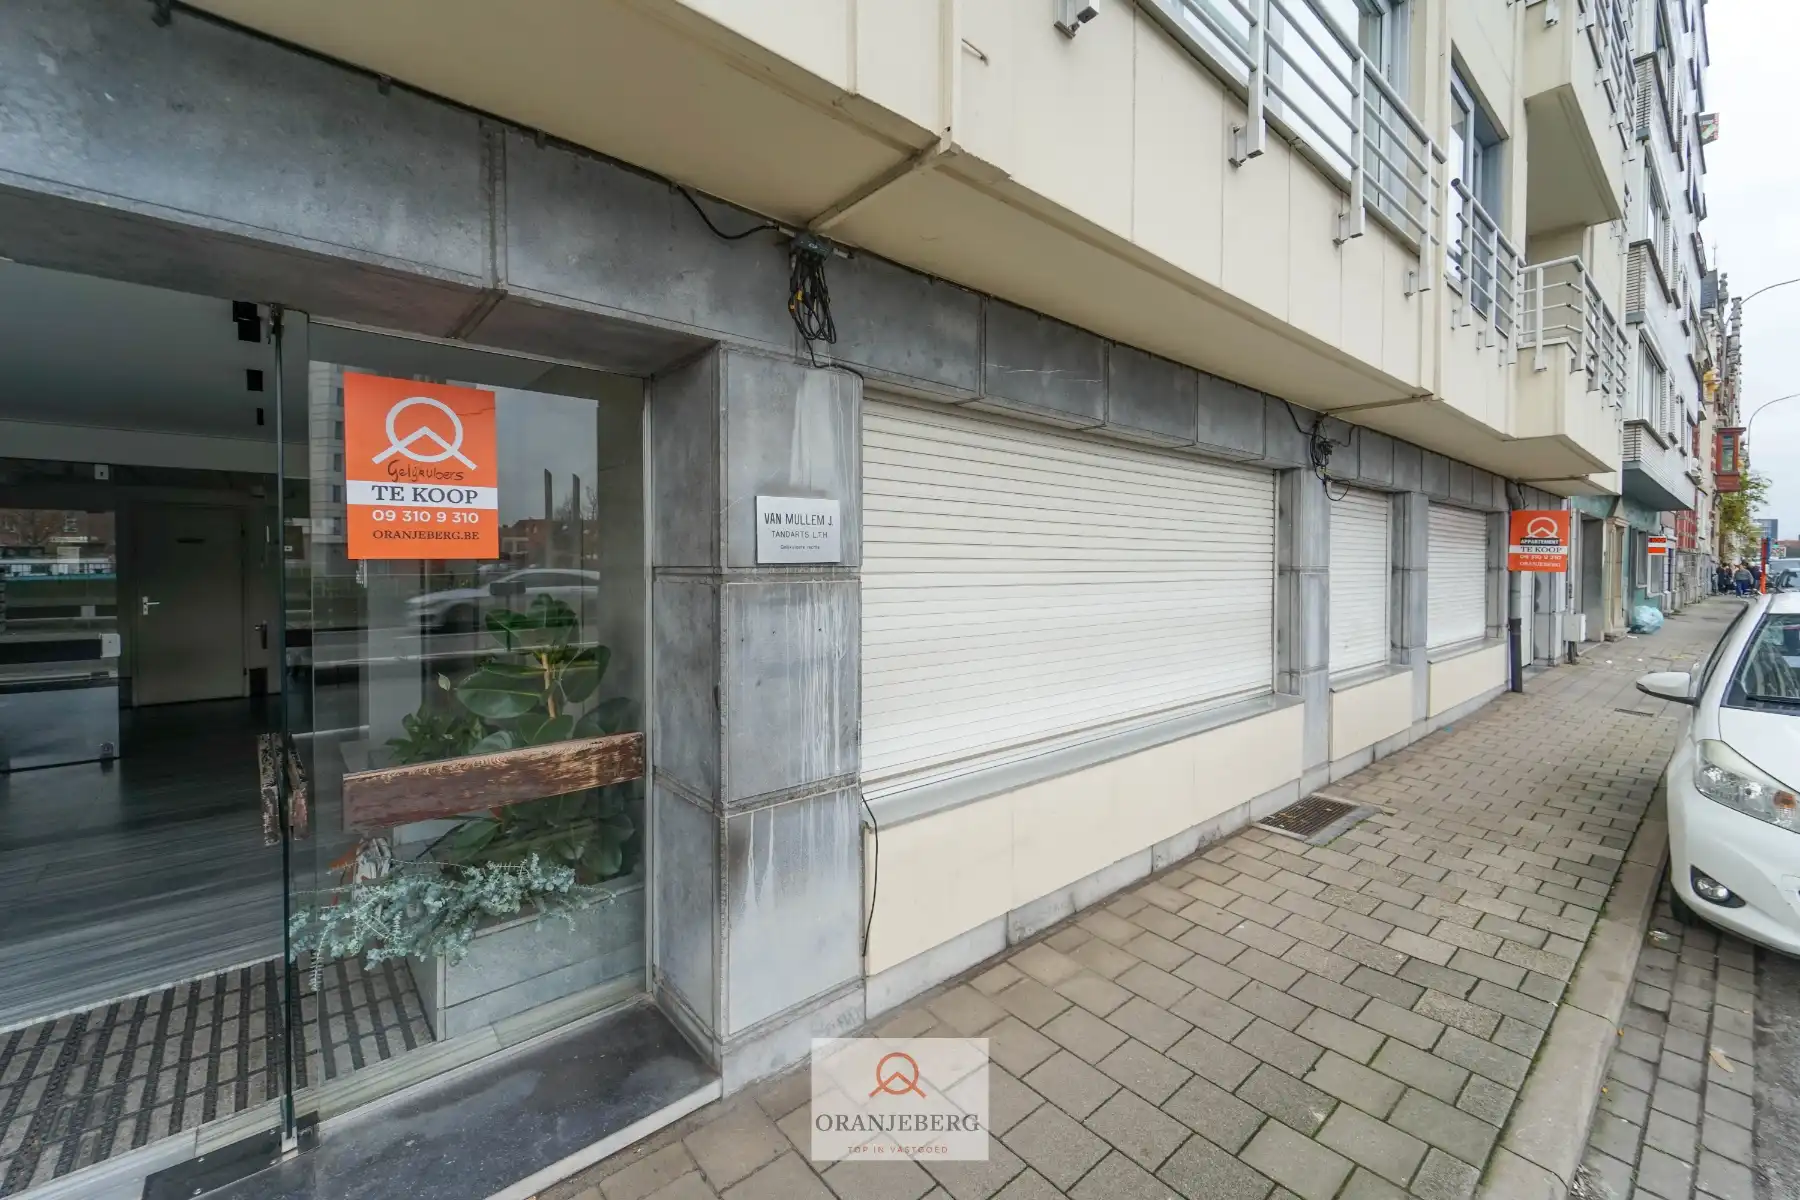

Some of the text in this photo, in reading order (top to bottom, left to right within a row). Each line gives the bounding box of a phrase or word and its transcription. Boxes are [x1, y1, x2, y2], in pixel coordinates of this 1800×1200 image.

[371, 485, 478, 504] TE KOOP
[372, 509, 479, 524] 09 310 9 310
[764, 512, 834, 526] VAN MULLEM J.
[372, 529, 480, 541] ORANJEBERG.BE
[771, 530, 810, 539] TANDARTS
